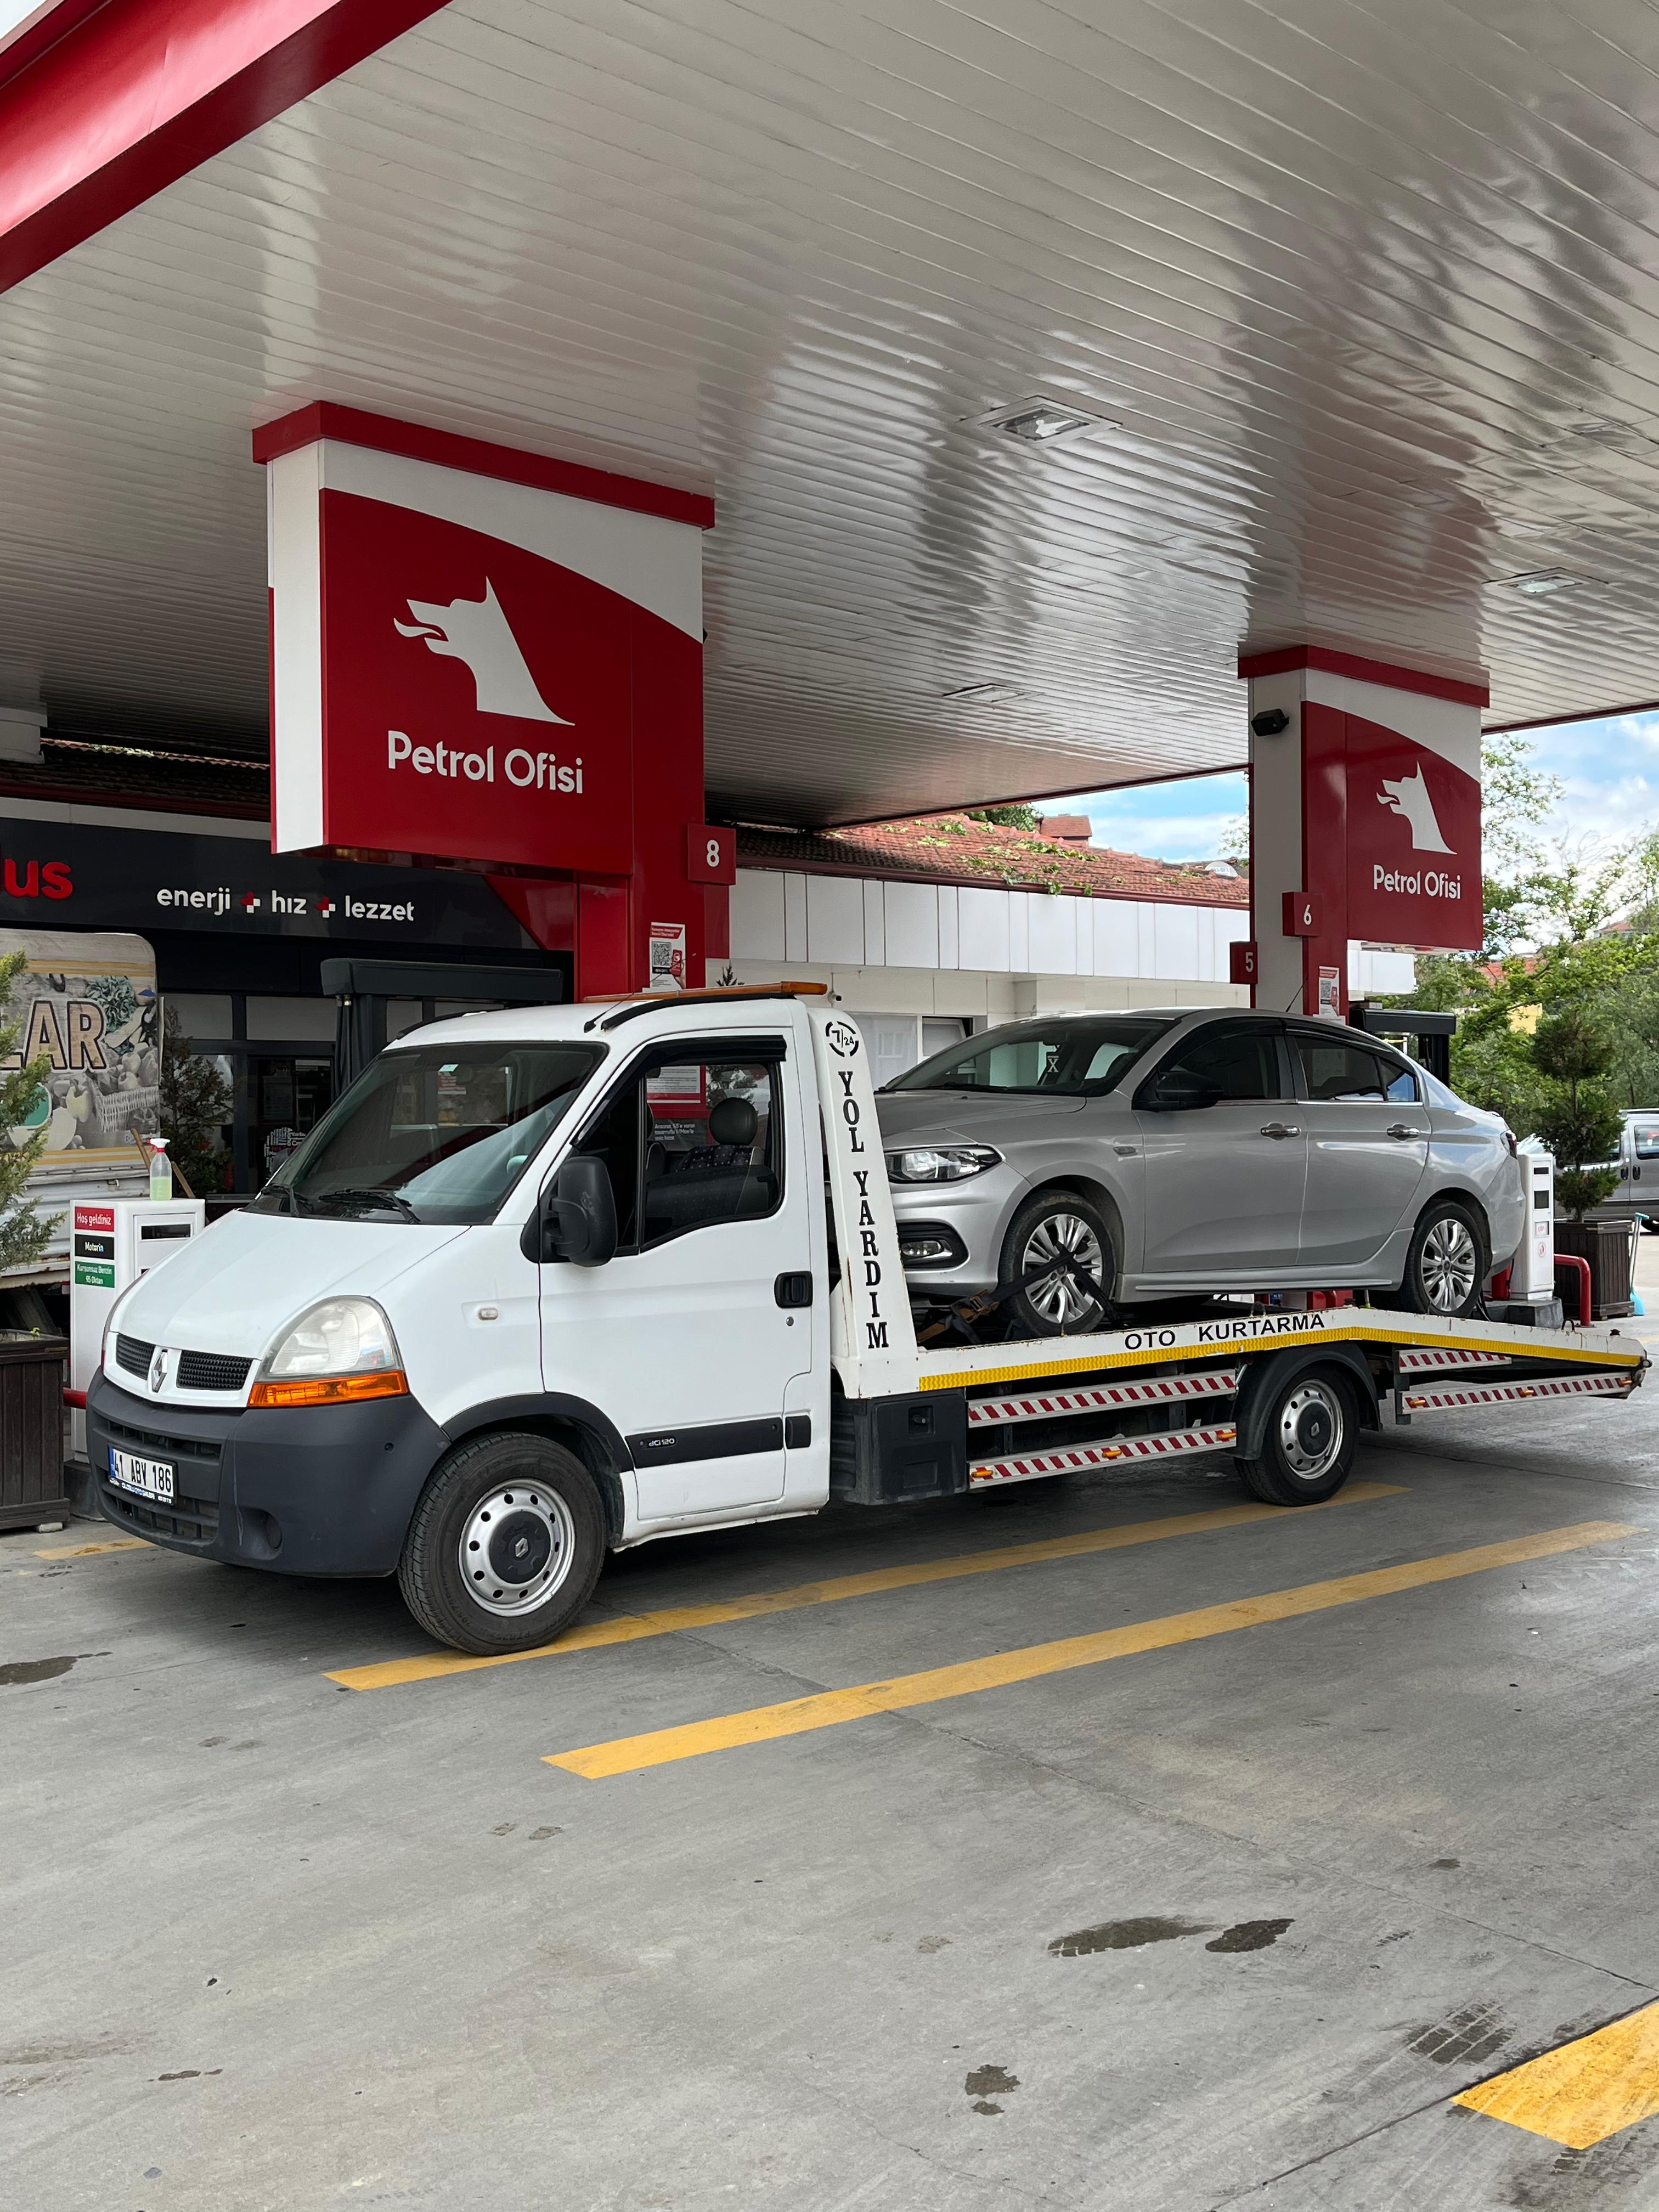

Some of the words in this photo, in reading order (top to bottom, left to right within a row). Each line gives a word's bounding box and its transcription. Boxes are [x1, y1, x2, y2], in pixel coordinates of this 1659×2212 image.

[388, 730, 493, 782] Petrol
[505, 748, 583, 794] Ofisi
[707, 839, 719, 867] 8
[1373, 864, 1421, 894] Petrol
[1425, 871, 1460, 899] Ofisi
[157, 887, 230, 916] enerji
[272, 890, 307, 914] hız
[345, 895, 414, 921] lezzet
[1304, 904, 1312, 926] 6
[1245, 951, 1254, 972] 5
[831, 1028, 854, 1048] 7/24
[77, 1212, 88, 1225] Hoş
[89, 1213, 111, 1226] geldiniz
[838, 1071, 865, 1153] YOL
[853, 1170, 889, 1349] YARDIM
[1125, 1319, 1176, 1350] OTO
[1199, 1314, 1325, 1342] KURTARMA
[153, 1465, 172, 1493] 186
